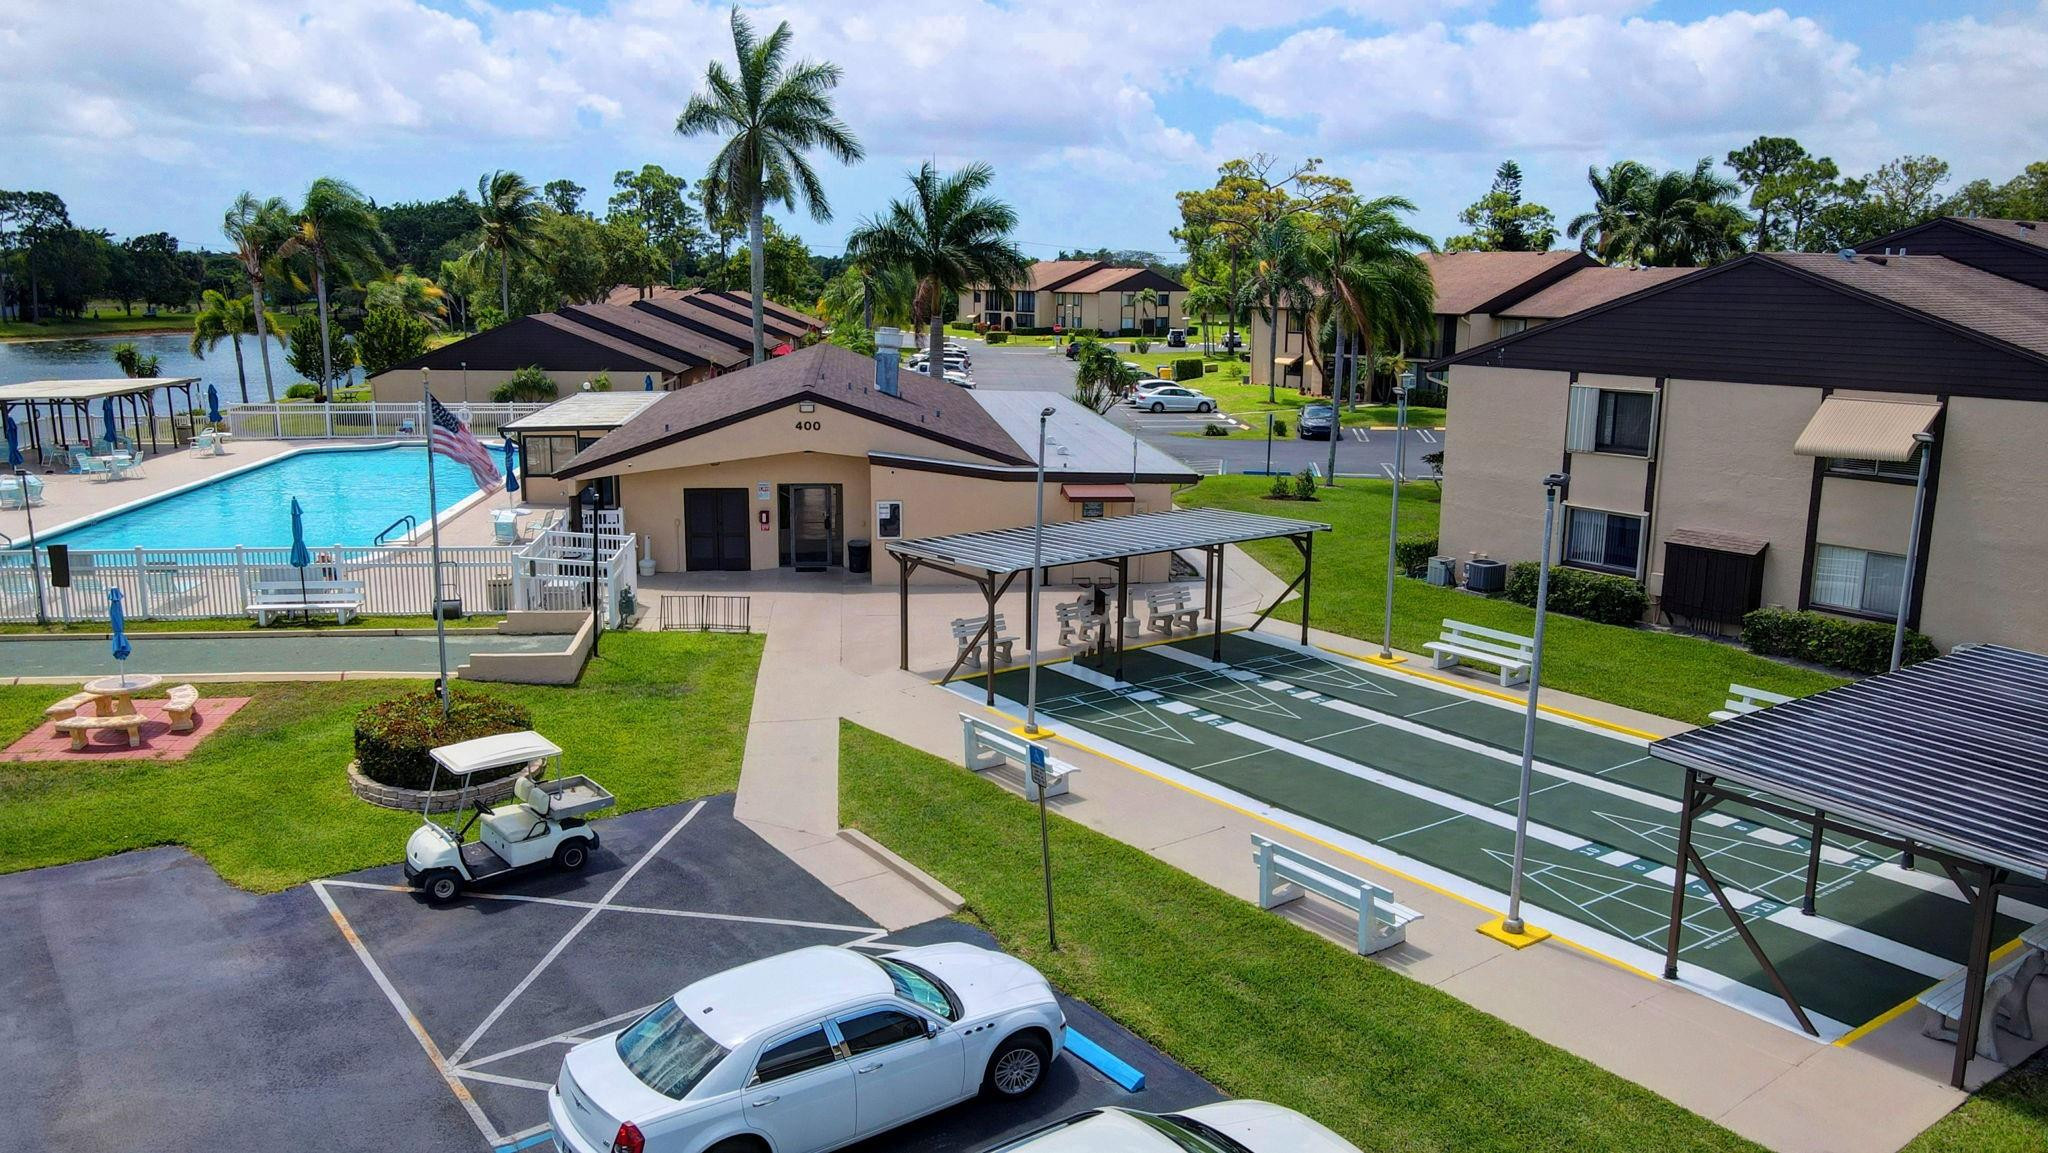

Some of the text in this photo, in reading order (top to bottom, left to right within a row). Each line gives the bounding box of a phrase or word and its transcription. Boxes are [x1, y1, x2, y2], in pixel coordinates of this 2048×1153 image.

[795, 421, 821, 431] 400
[1579, 847, 1601, 857] 10
[1692, 884, 1707, 892] 7
[1752, 902, 1778, 914] -10
